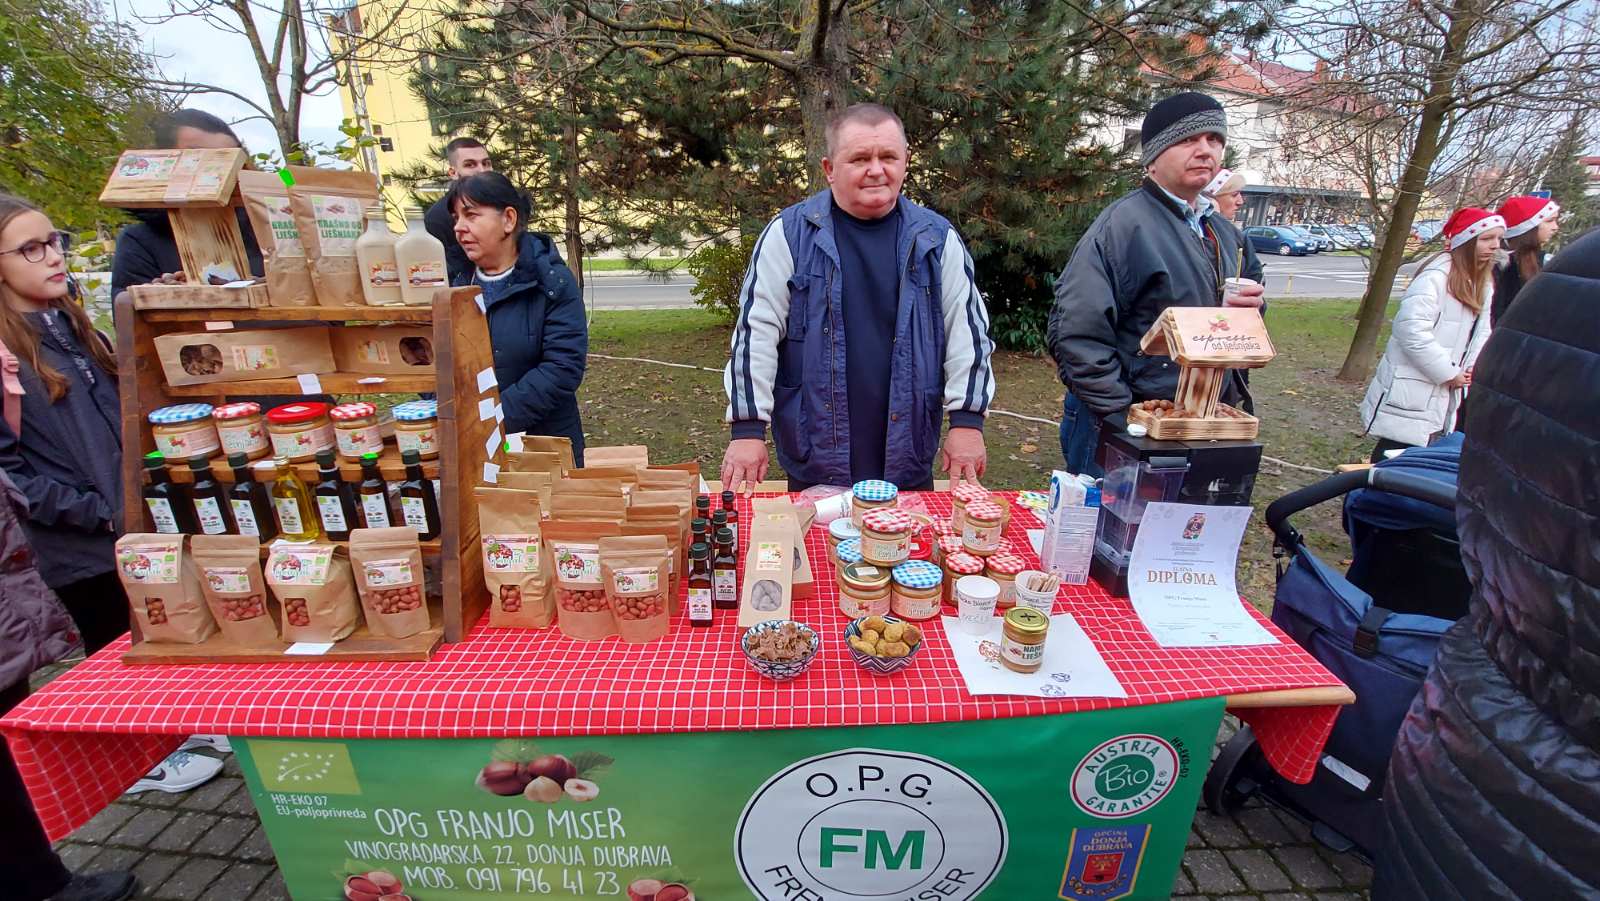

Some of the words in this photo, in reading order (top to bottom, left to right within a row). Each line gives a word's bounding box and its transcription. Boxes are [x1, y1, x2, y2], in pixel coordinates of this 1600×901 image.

[1192, 335, 1256, 351] espresso
[1147, 570, 1218, 586] DIPLOMA
[1085, 740, 1161, 773] AUSTRIA
[805, 765, 932, 805] O.P.G.
[1098, 764, 1149, 792] Bio
[270, 793, 312, 805] HR-EKO
[314, 795, 327, 806] 07
[276, 805, 367, 819] EU-poljoprivreda
[374, 808, 428, 838] OPG
[436, 807, 535, 841] FRANJO
[547, 807, 626, 840] MISER
[345, 840, 485, 865] VINOGRADARSKA
[526, 844, 586, 867] DONJA
[593, 845, 672, 868] DUBRAVA
[819, 826, 926, 871] FM
[1082, 842, 1133, 852] DUBRAVA
[1091, 836, 1128, 845] DONJA
[403, 865, 459, 891] MOB.
[466, 867, 502, 893] 091
[510, 867, 551, 894] 796
[563, 868, 584, 895] 41
[594, 871, 621, 895] 23
